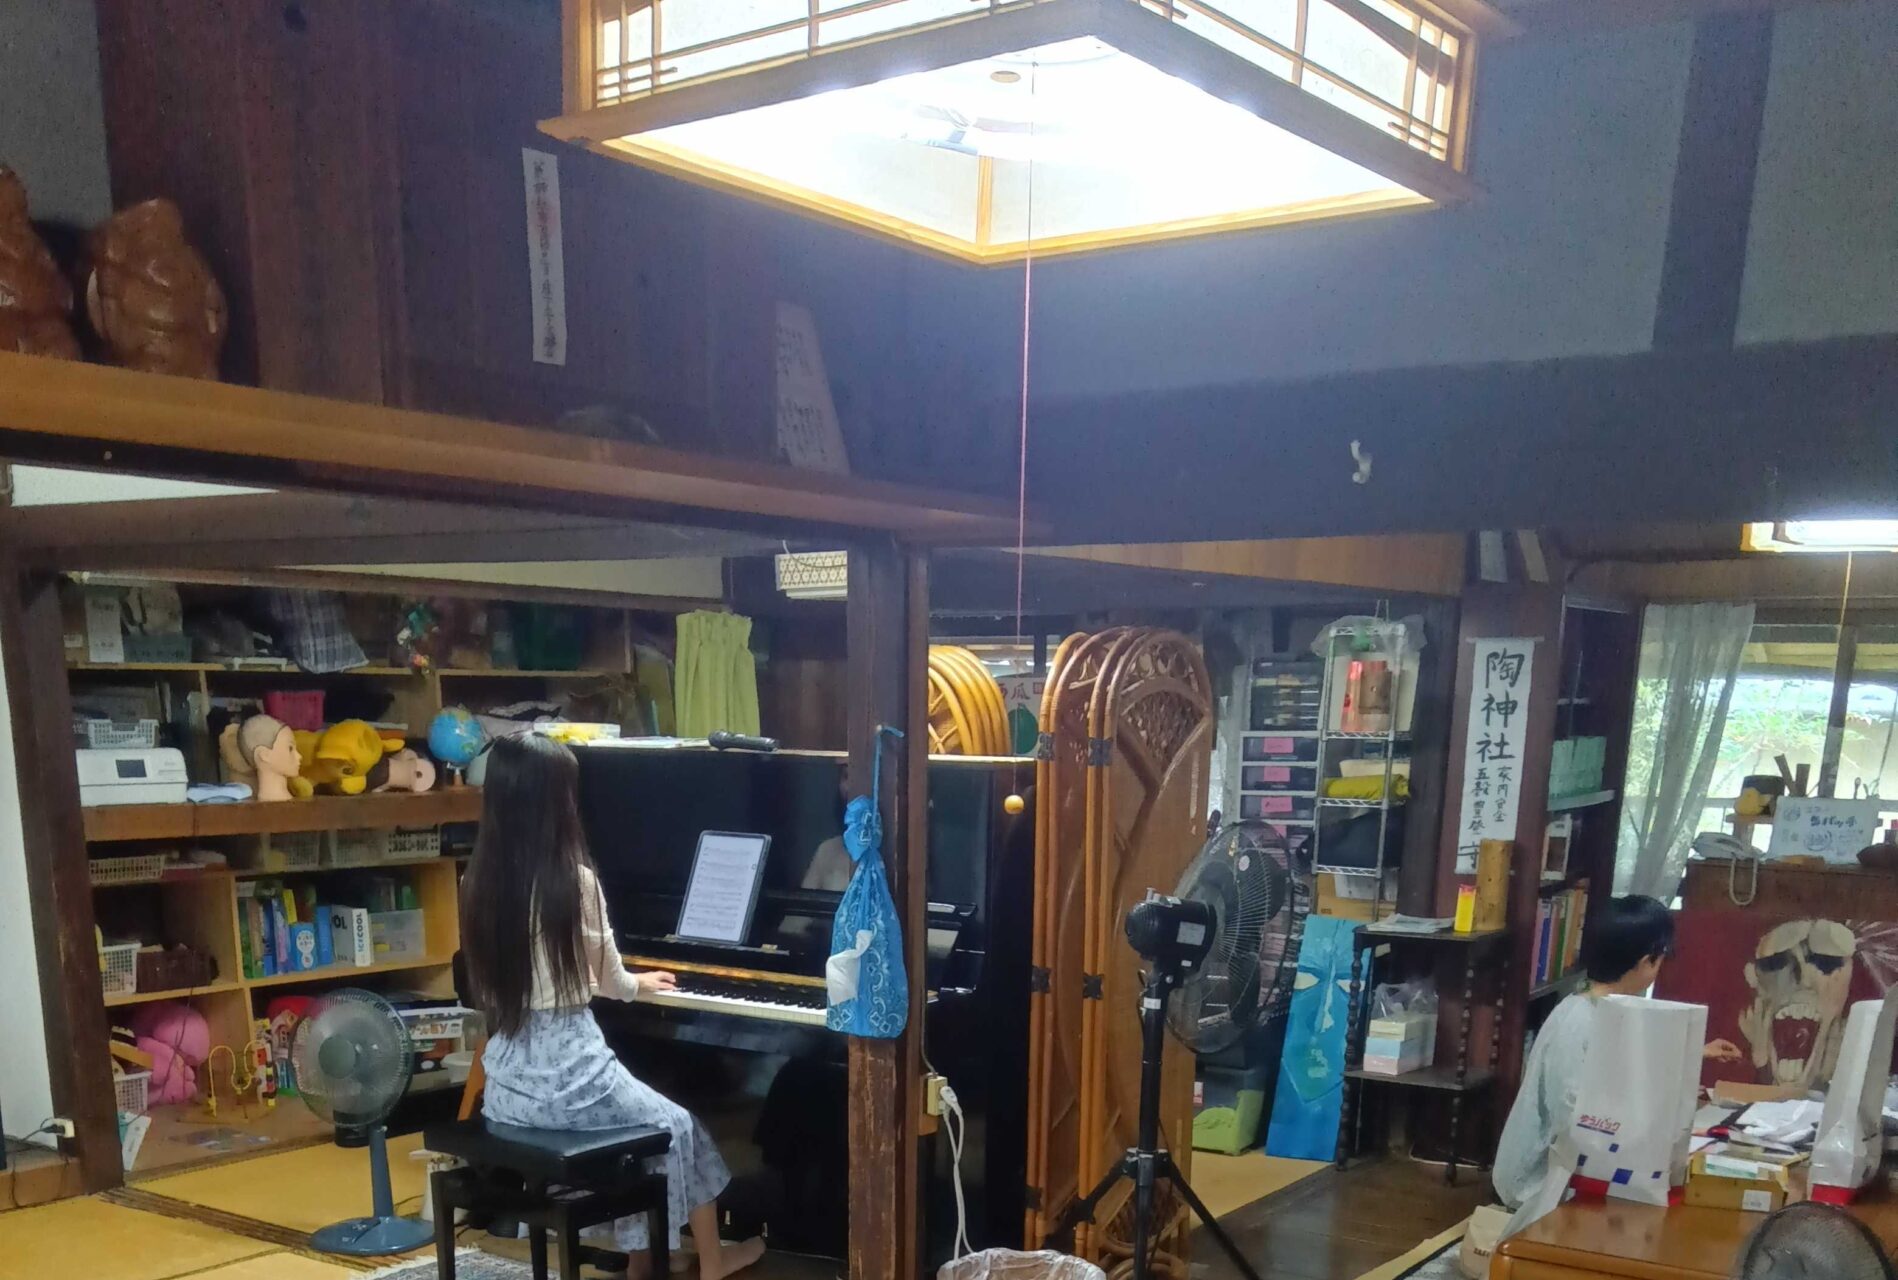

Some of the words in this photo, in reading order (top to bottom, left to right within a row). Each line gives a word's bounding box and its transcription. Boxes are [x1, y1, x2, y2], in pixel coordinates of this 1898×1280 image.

[1475, 647, 1525, 763] 陶神社
[1493, 766, 1513, 822] 家内安全
